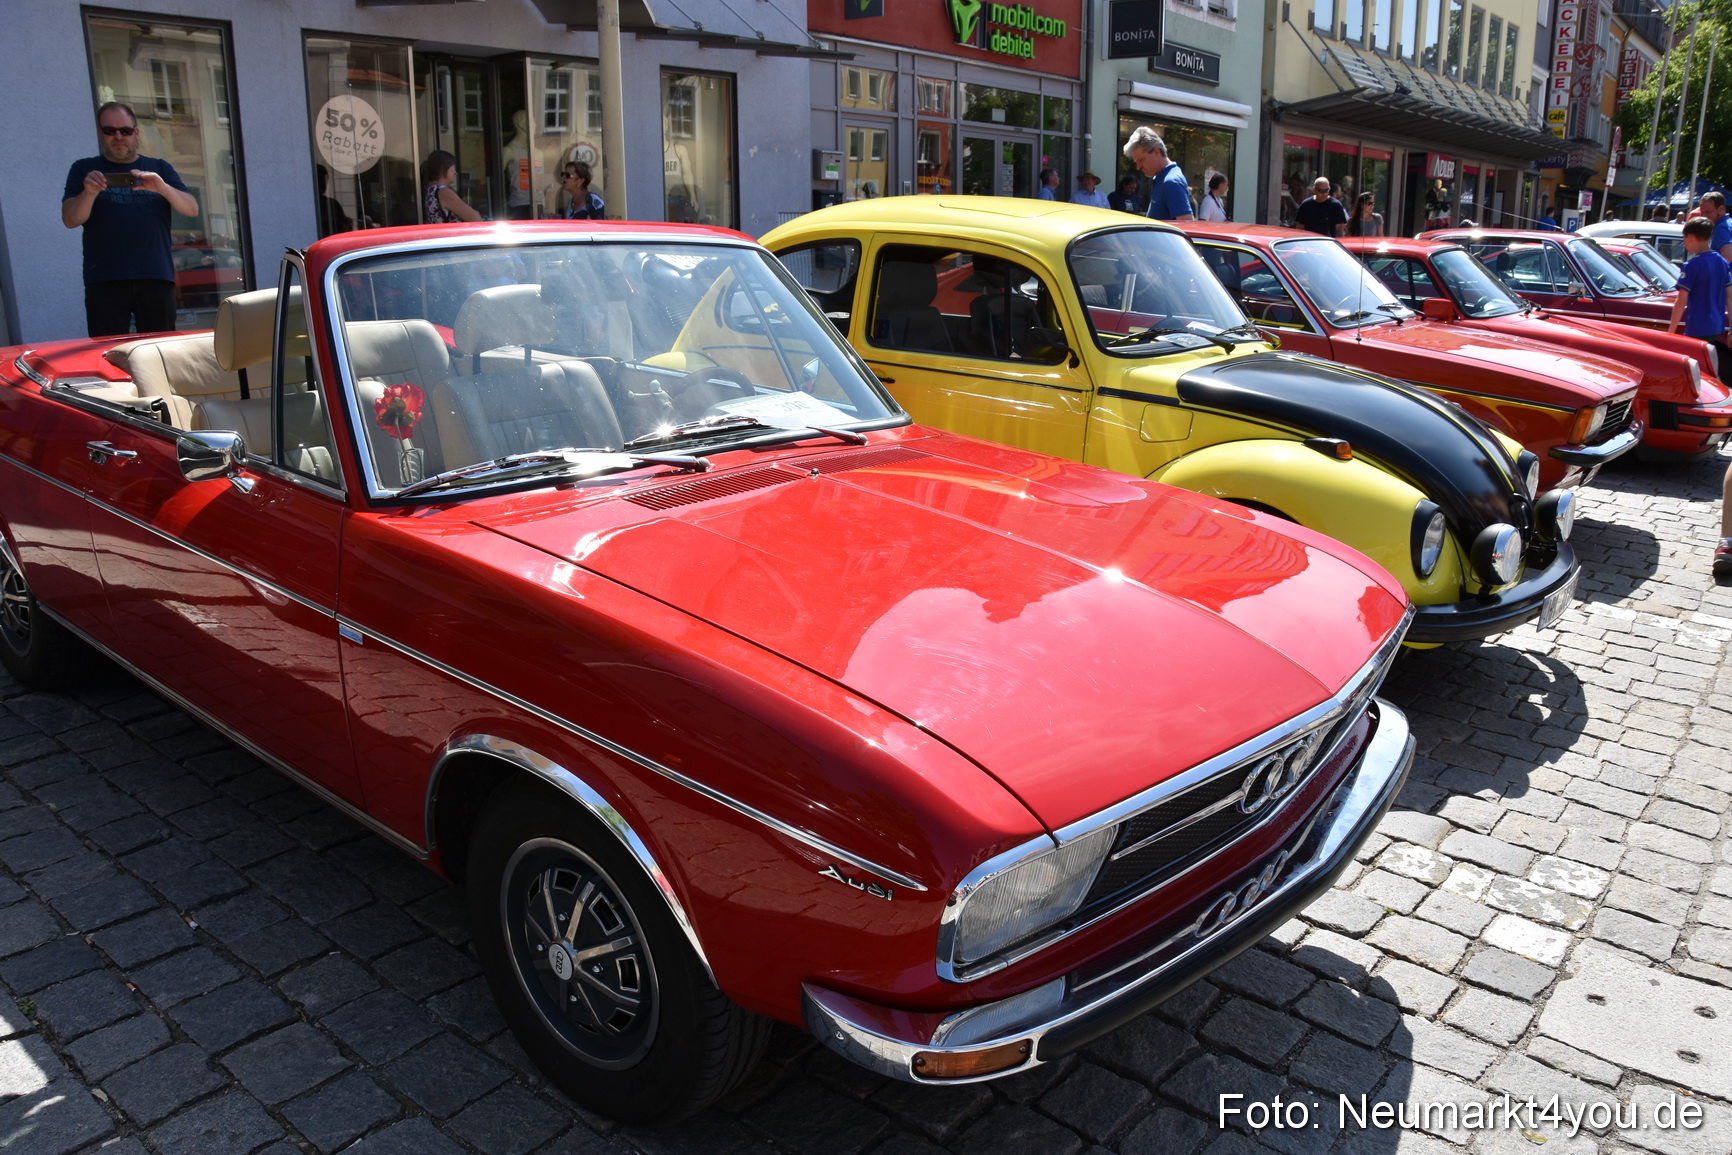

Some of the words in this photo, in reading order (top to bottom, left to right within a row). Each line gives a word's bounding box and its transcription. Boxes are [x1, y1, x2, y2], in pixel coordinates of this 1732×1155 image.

[992, 3, 1066, 38] mobilcom
[991, 29, 1035, 59] debitel
[322, 130, 377, 155] Rabatt
[1432, 154, 1455, 179] ADLER
[1569, 220, 1576, 230] P
[818, 865, 893, 901] Audi
